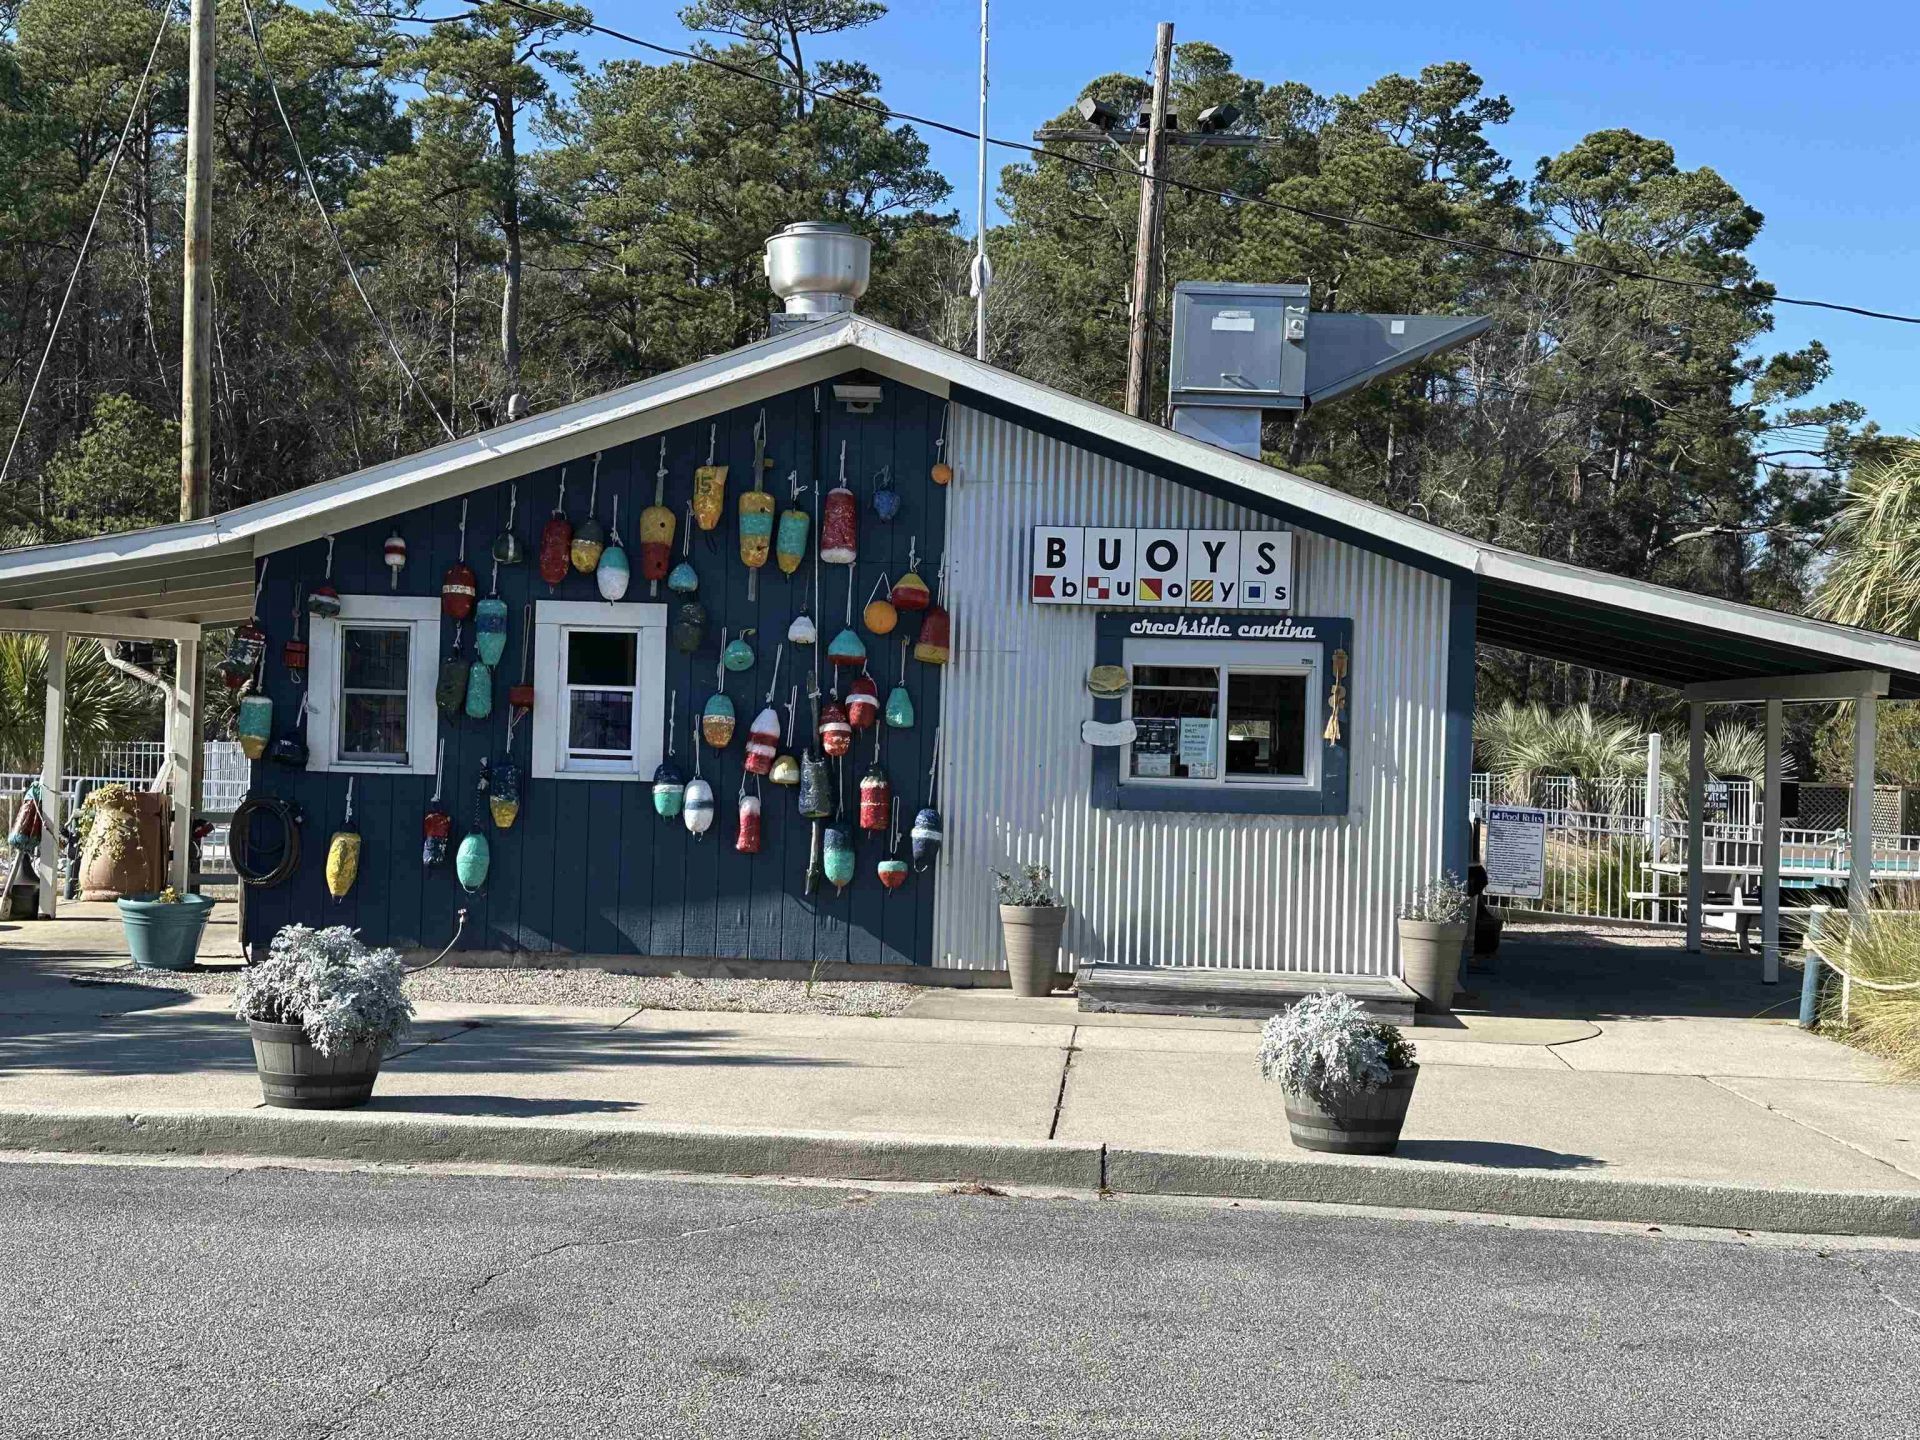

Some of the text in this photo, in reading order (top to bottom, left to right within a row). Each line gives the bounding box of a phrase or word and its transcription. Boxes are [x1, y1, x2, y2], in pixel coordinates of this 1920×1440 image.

[1046, 537, 1276, 575] BUOYS
[1130, 616, 1316, 639] creekside cantina
[1501, 812, 1520, 822] Pool
